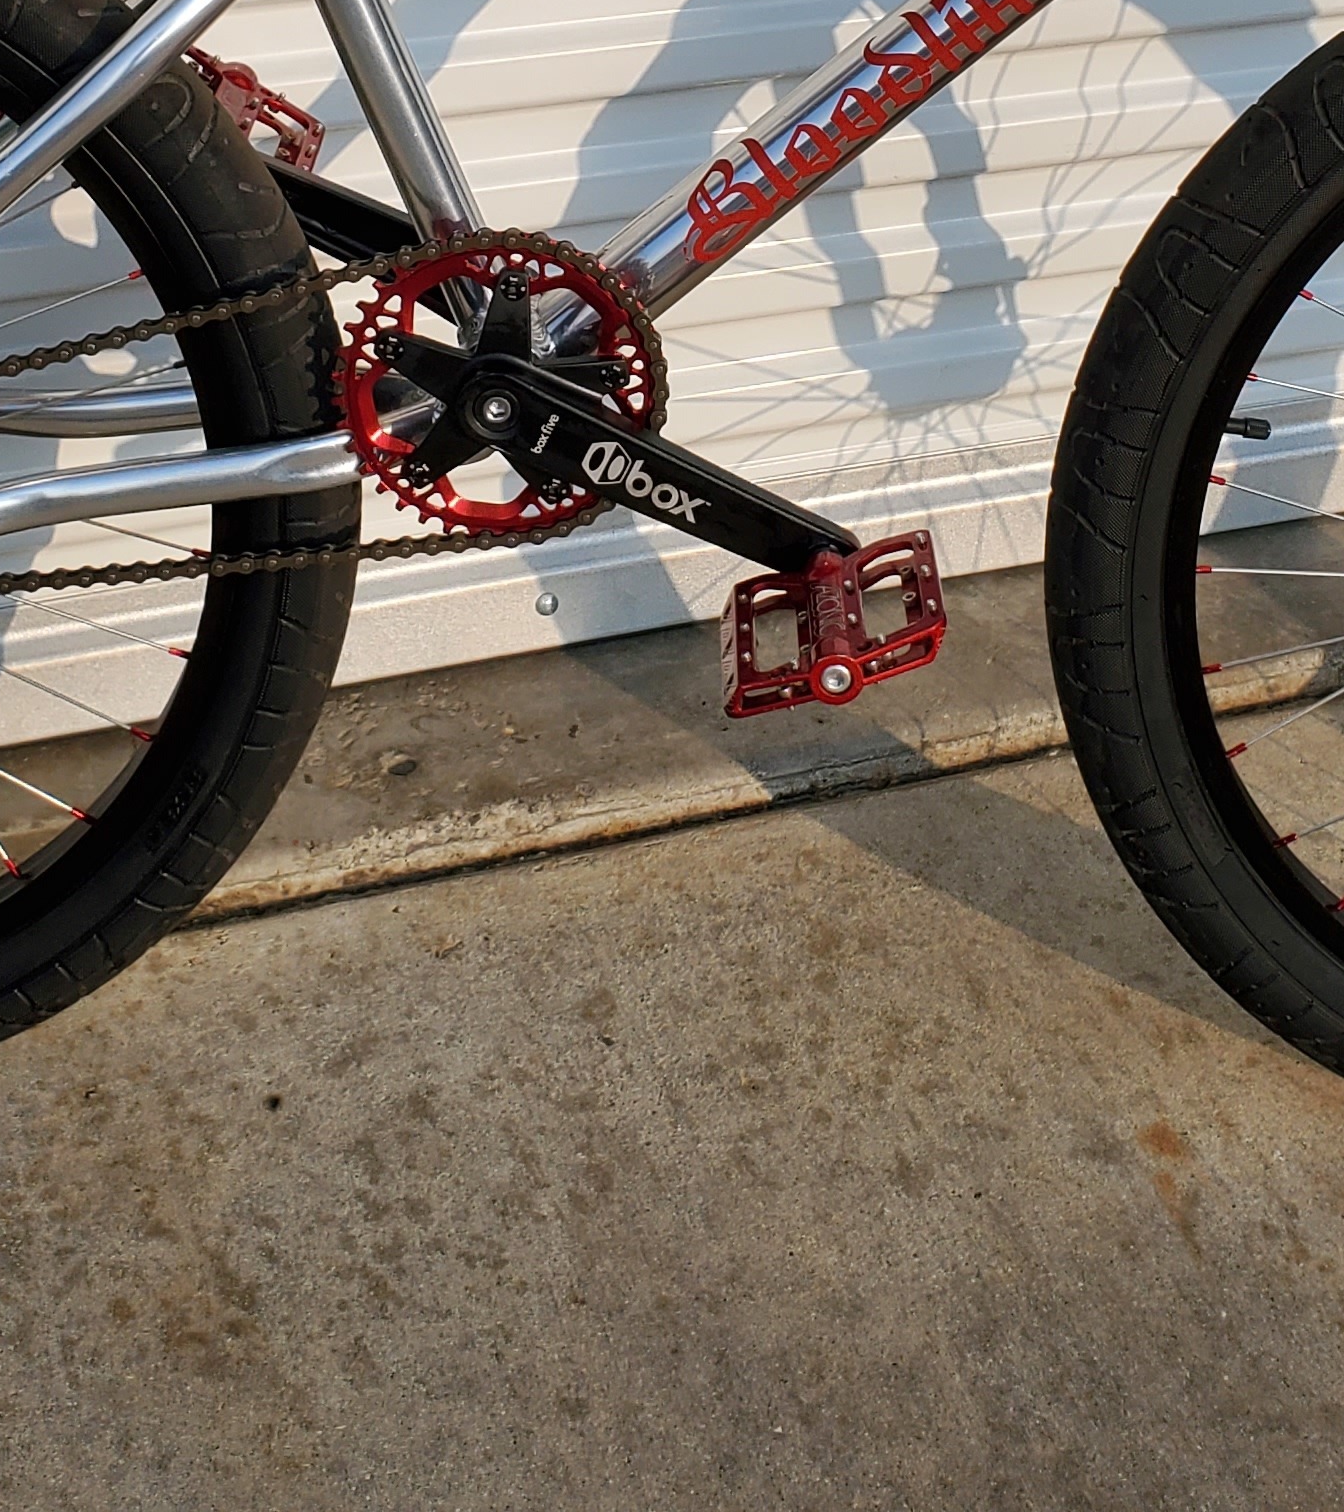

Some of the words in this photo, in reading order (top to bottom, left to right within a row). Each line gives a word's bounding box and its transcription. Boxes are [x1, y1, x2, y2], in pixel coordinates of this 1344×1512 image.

[530, 435, 549, 455] box
[540, 414, 560, 440] five
[625, 459, 707, 524] box
